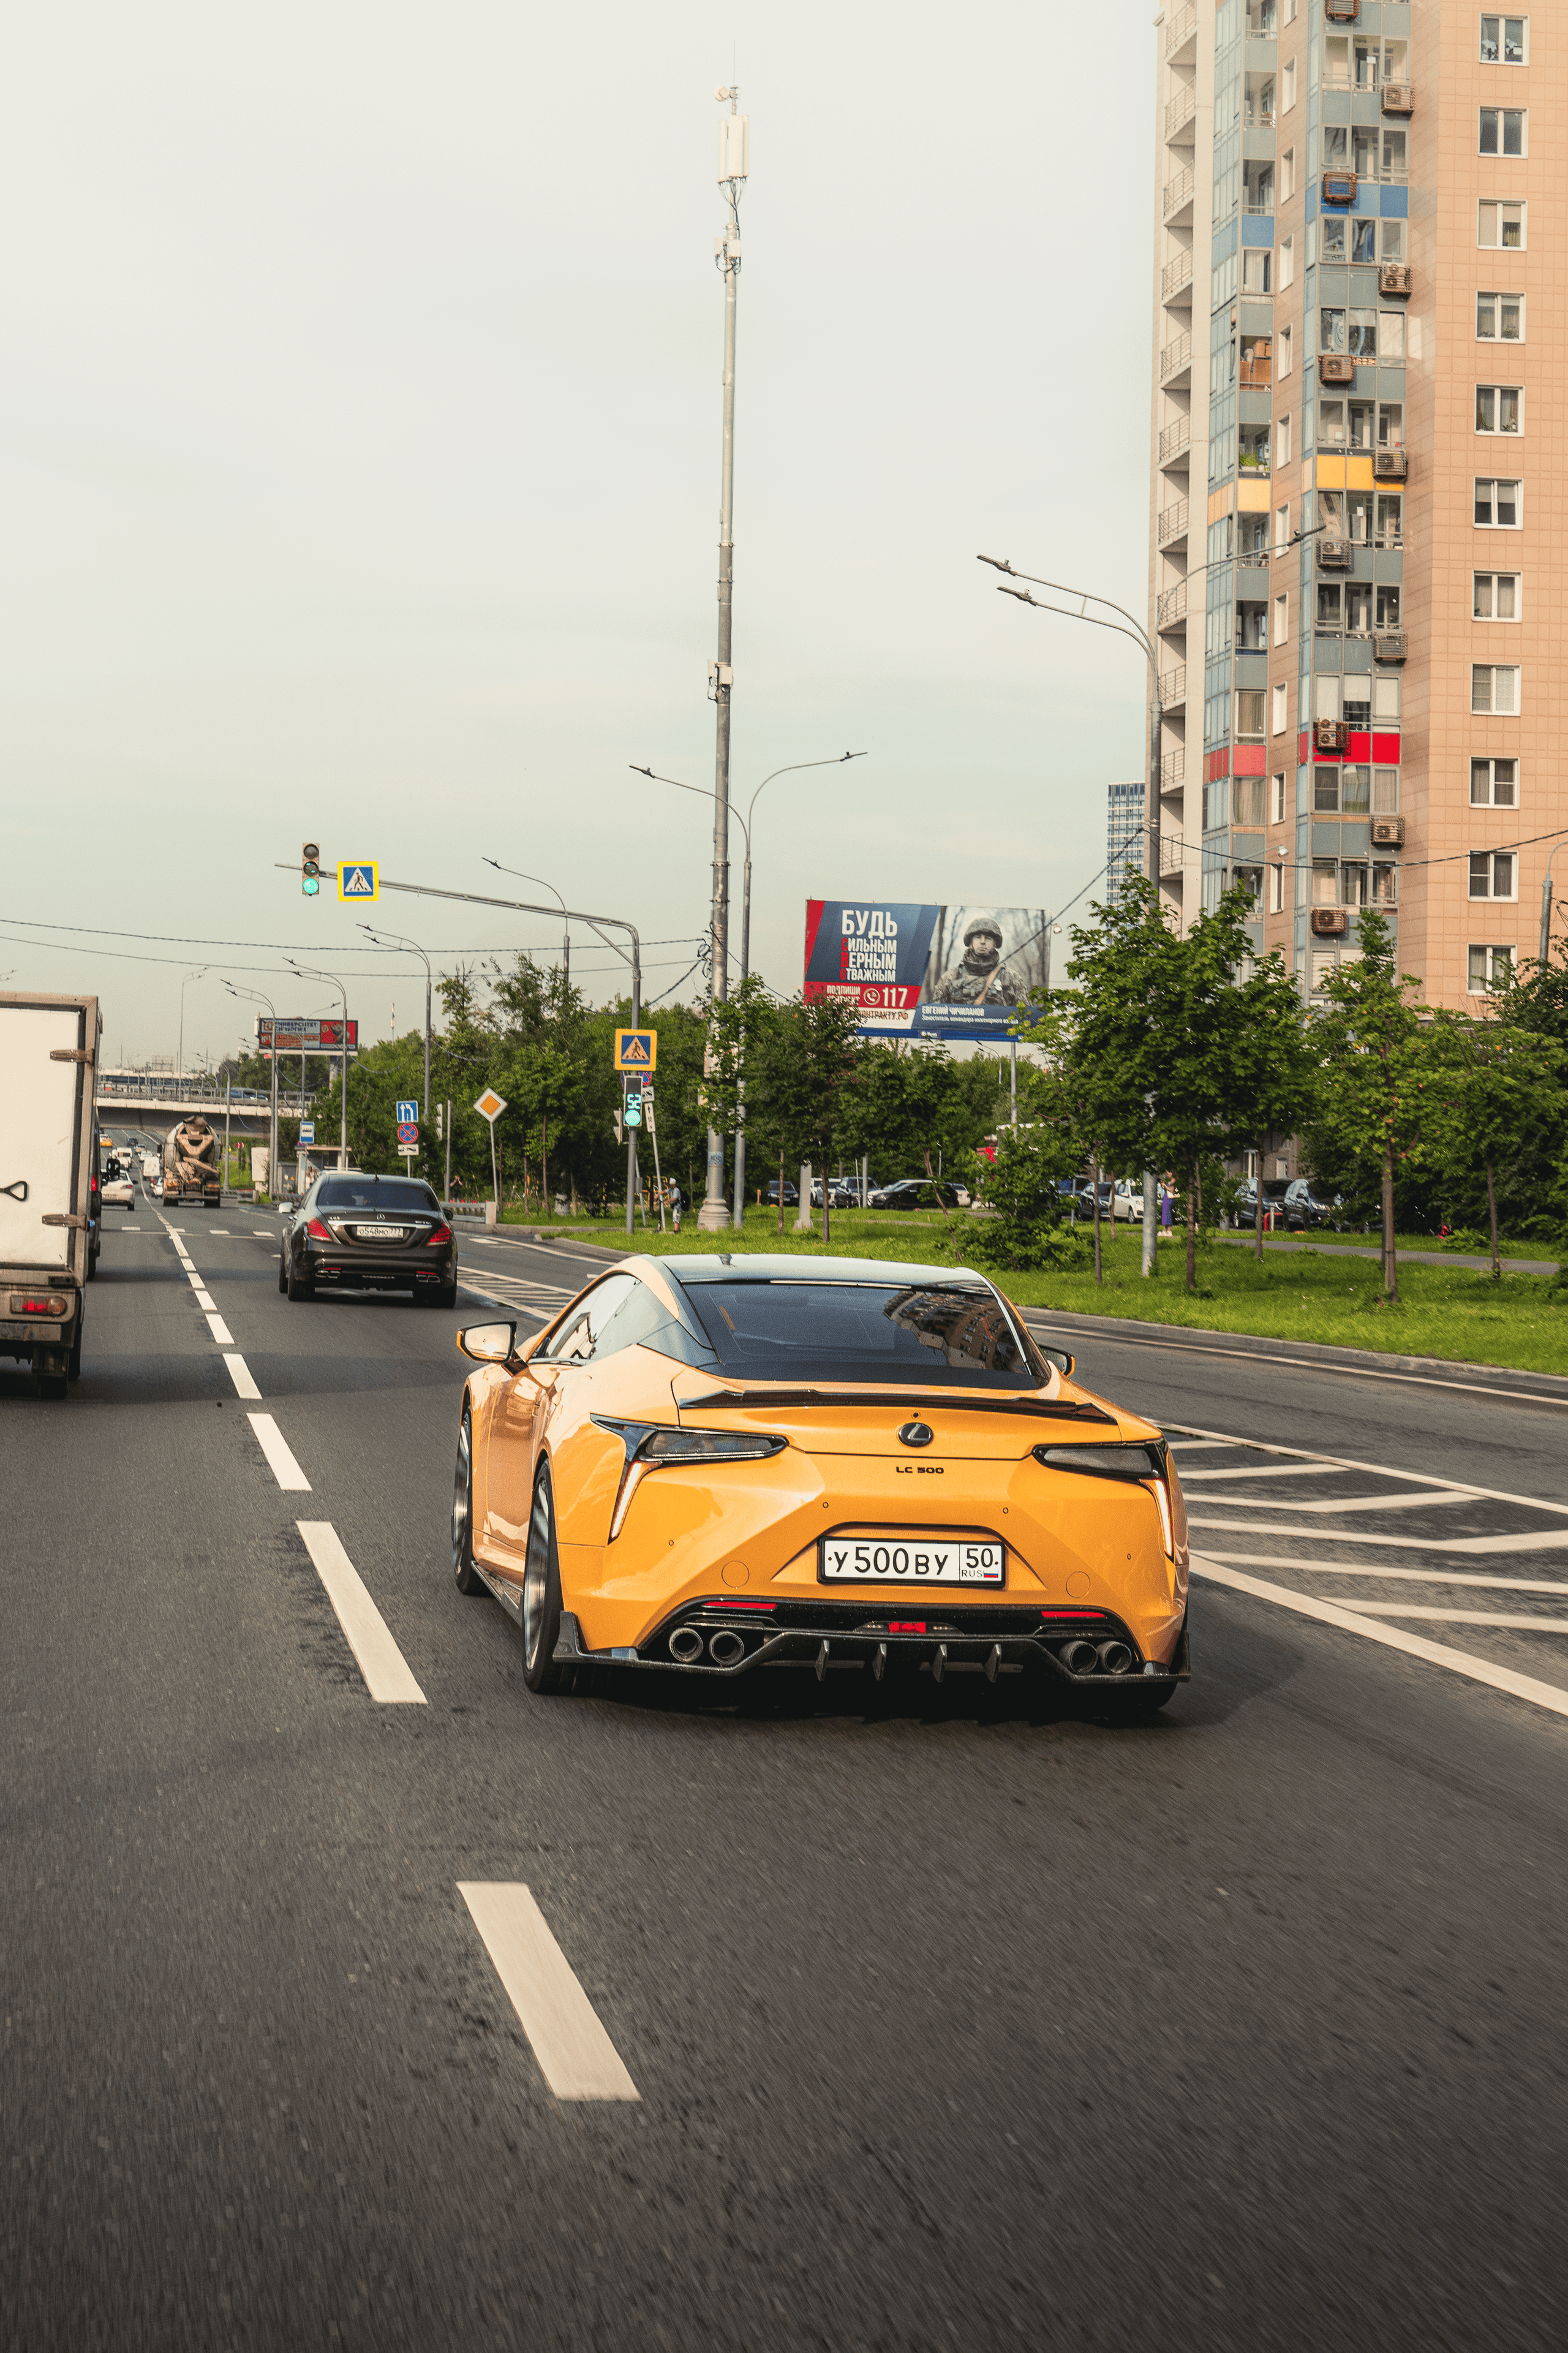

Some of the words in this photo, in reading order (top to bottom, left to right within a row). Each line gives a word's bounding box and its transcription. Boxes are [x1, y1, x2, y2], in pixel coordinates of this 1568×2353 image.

[842, 910, 898, 940] БУДЬ
[841, 937, 897, 954] СИЛЬНЫМ
[840, 951, 896, 970] ВЕРНЫМ
[840, 968, 896, 982] ОТВАЖНЫМ
[827, 984, 861, 997] ПОДПИШИ
[882, 987, 908, 1008] 117
[922, 1005, 949, 1014] ЕВГЕНИЙ
[627, 1093, 642, 1109] 52
[834, 1546, 949, 1575] У500ВУ
[966, 1547, 993, 1568] 50
